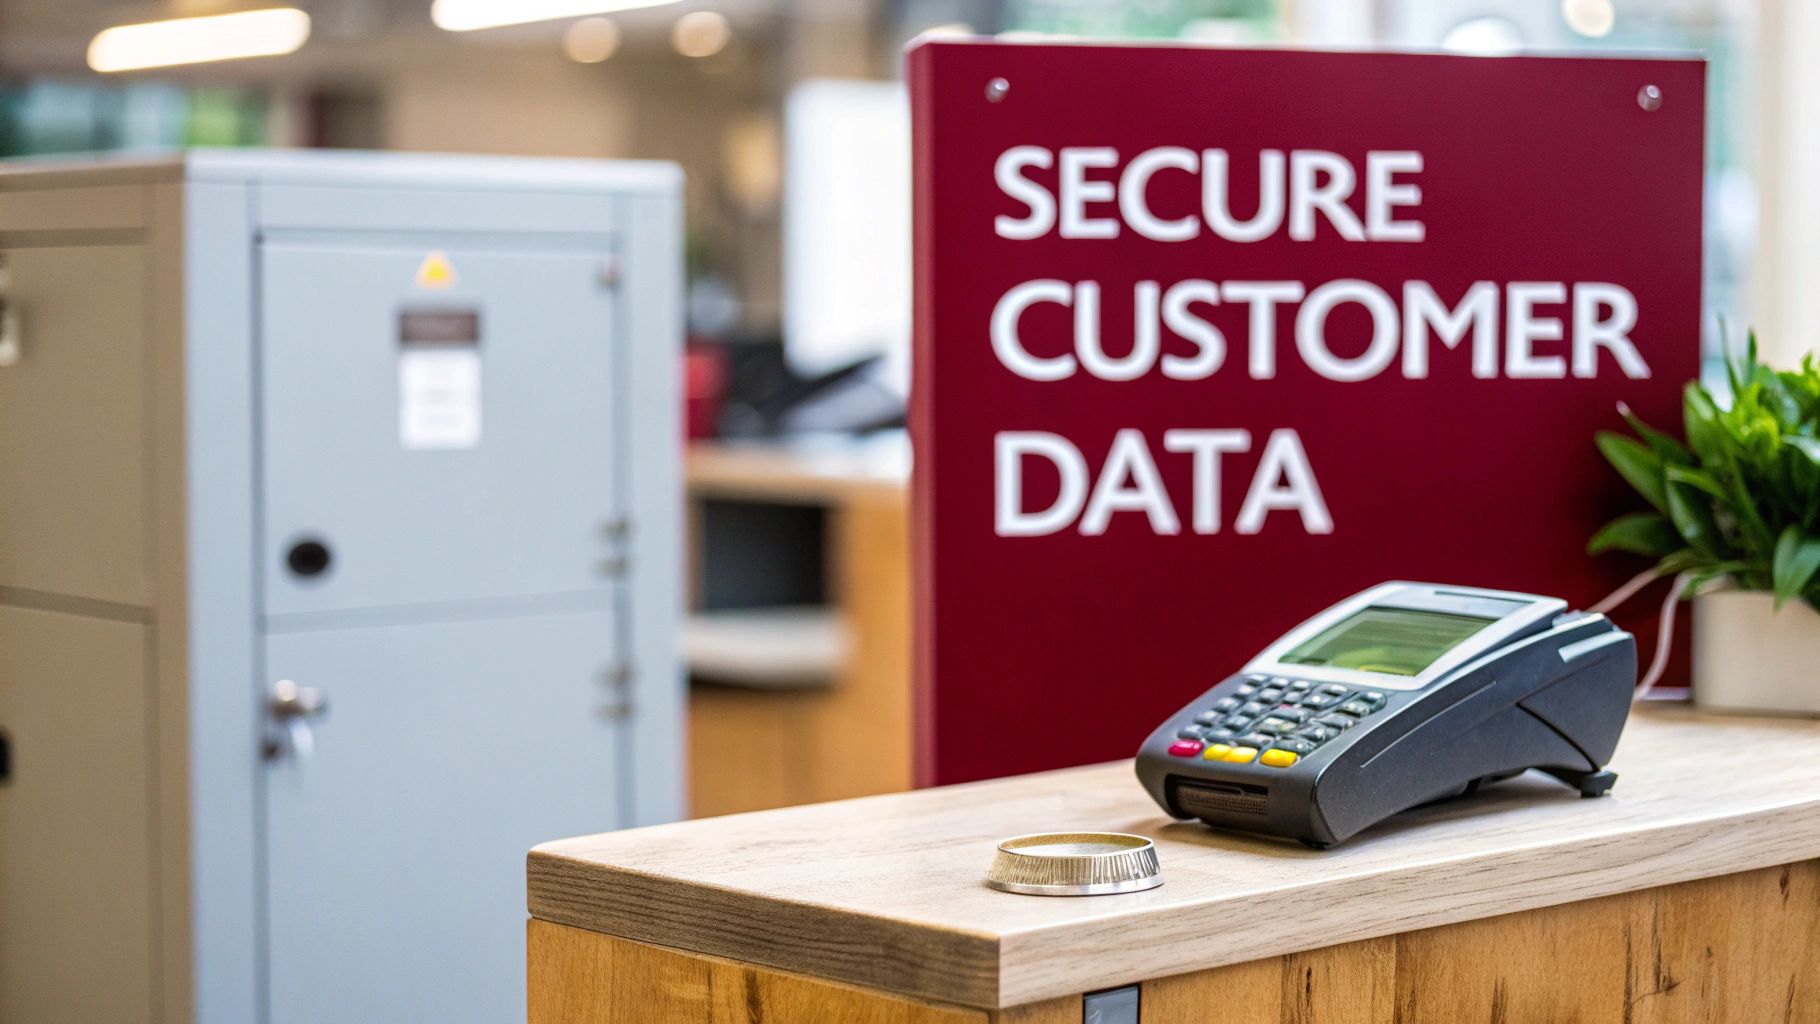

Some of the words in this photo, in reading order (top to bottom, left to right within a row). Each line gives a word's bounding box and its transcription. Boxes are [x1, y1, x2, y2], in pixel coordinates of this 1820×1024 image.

[994, 145, 1425, 243] SECURE
[990, 279, 1649, 382] CUSTOMER
[994, 428, 1333, 537] DATA
